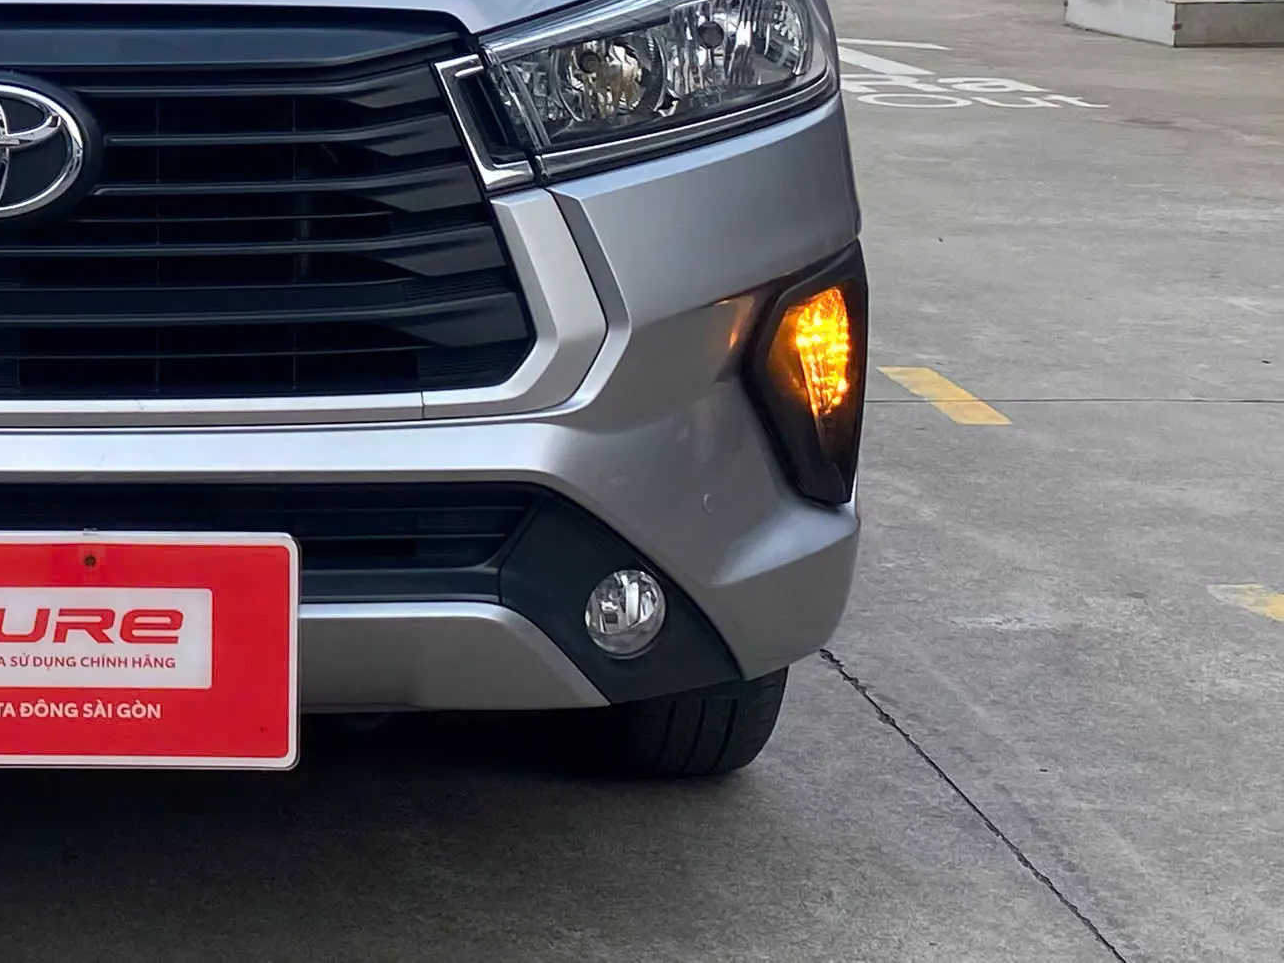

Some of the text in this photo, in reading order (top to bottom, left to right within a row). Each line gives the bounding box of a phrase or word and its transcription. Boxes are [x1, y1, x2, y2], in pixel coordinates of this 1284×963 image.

[9, 652, 30, 668] SỬ
[32, 656, 77, 671] DỤNG
[80, 652, 128, 669] CHÍNH
[132, 654, 177, 669] HÃNG
[19, 698, 78, 719] ĐÔNG
[82, 699, 113, 719] SÀI
[116, 699, 162, 719] GÒN
